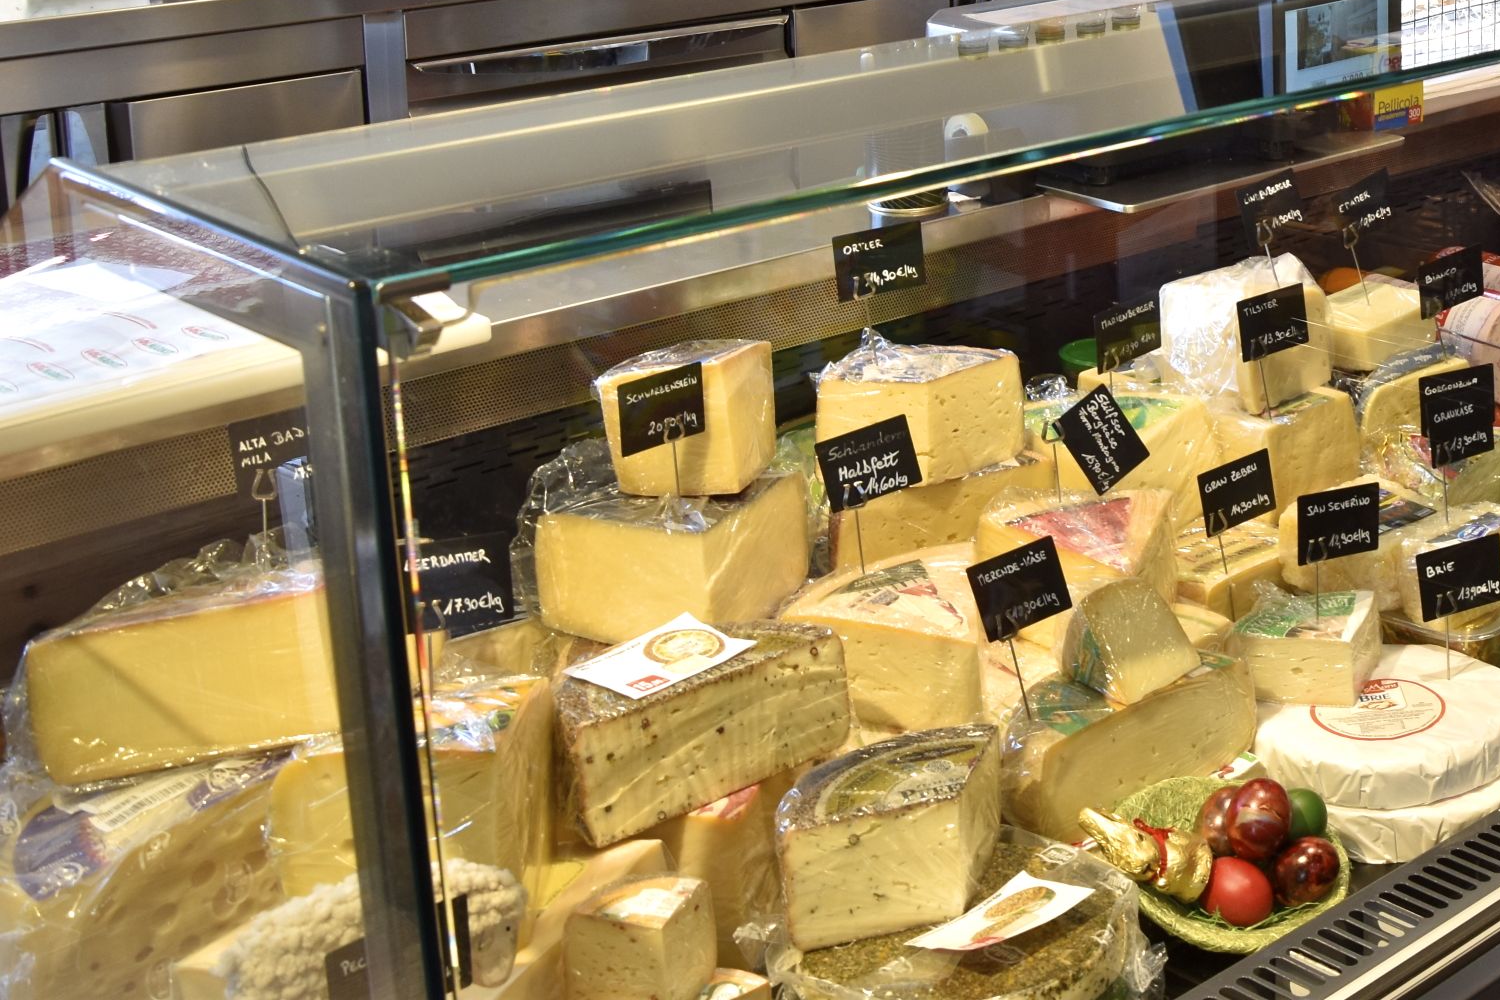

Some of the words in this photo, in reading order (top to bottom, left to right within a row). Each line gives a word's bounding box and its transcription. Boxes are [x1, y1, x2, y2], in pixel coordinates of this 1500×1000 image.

[1378, 95, 1419, 115] Pellicola
[1408, 107, 1421, 118] 300
[843, 239, 884, 255] ORTLER
[1243, 298, 1279, 316] TILSITER
[1424, 377, 1478, 396] GORGONZOLA
[1095, 393, 1125, 436] Stilfser
[1087, 400, 1118, 449] Bergkäse
[239, 436, 267, 452] ALTA
[271, 425, 311, 446] BADI
[241, 452, 272, 468] MILA
[839, 450, 900, 481] Halbfett
[1204, 476, 1228, 494] GRAN
[1230, 462, 1257, 482] ZEBRU
[1306, 504, 1326, 517] SAN
[404, 548, 491, 572] LEERDAMMER
[1359, 693, 1392, 703] BRIE
